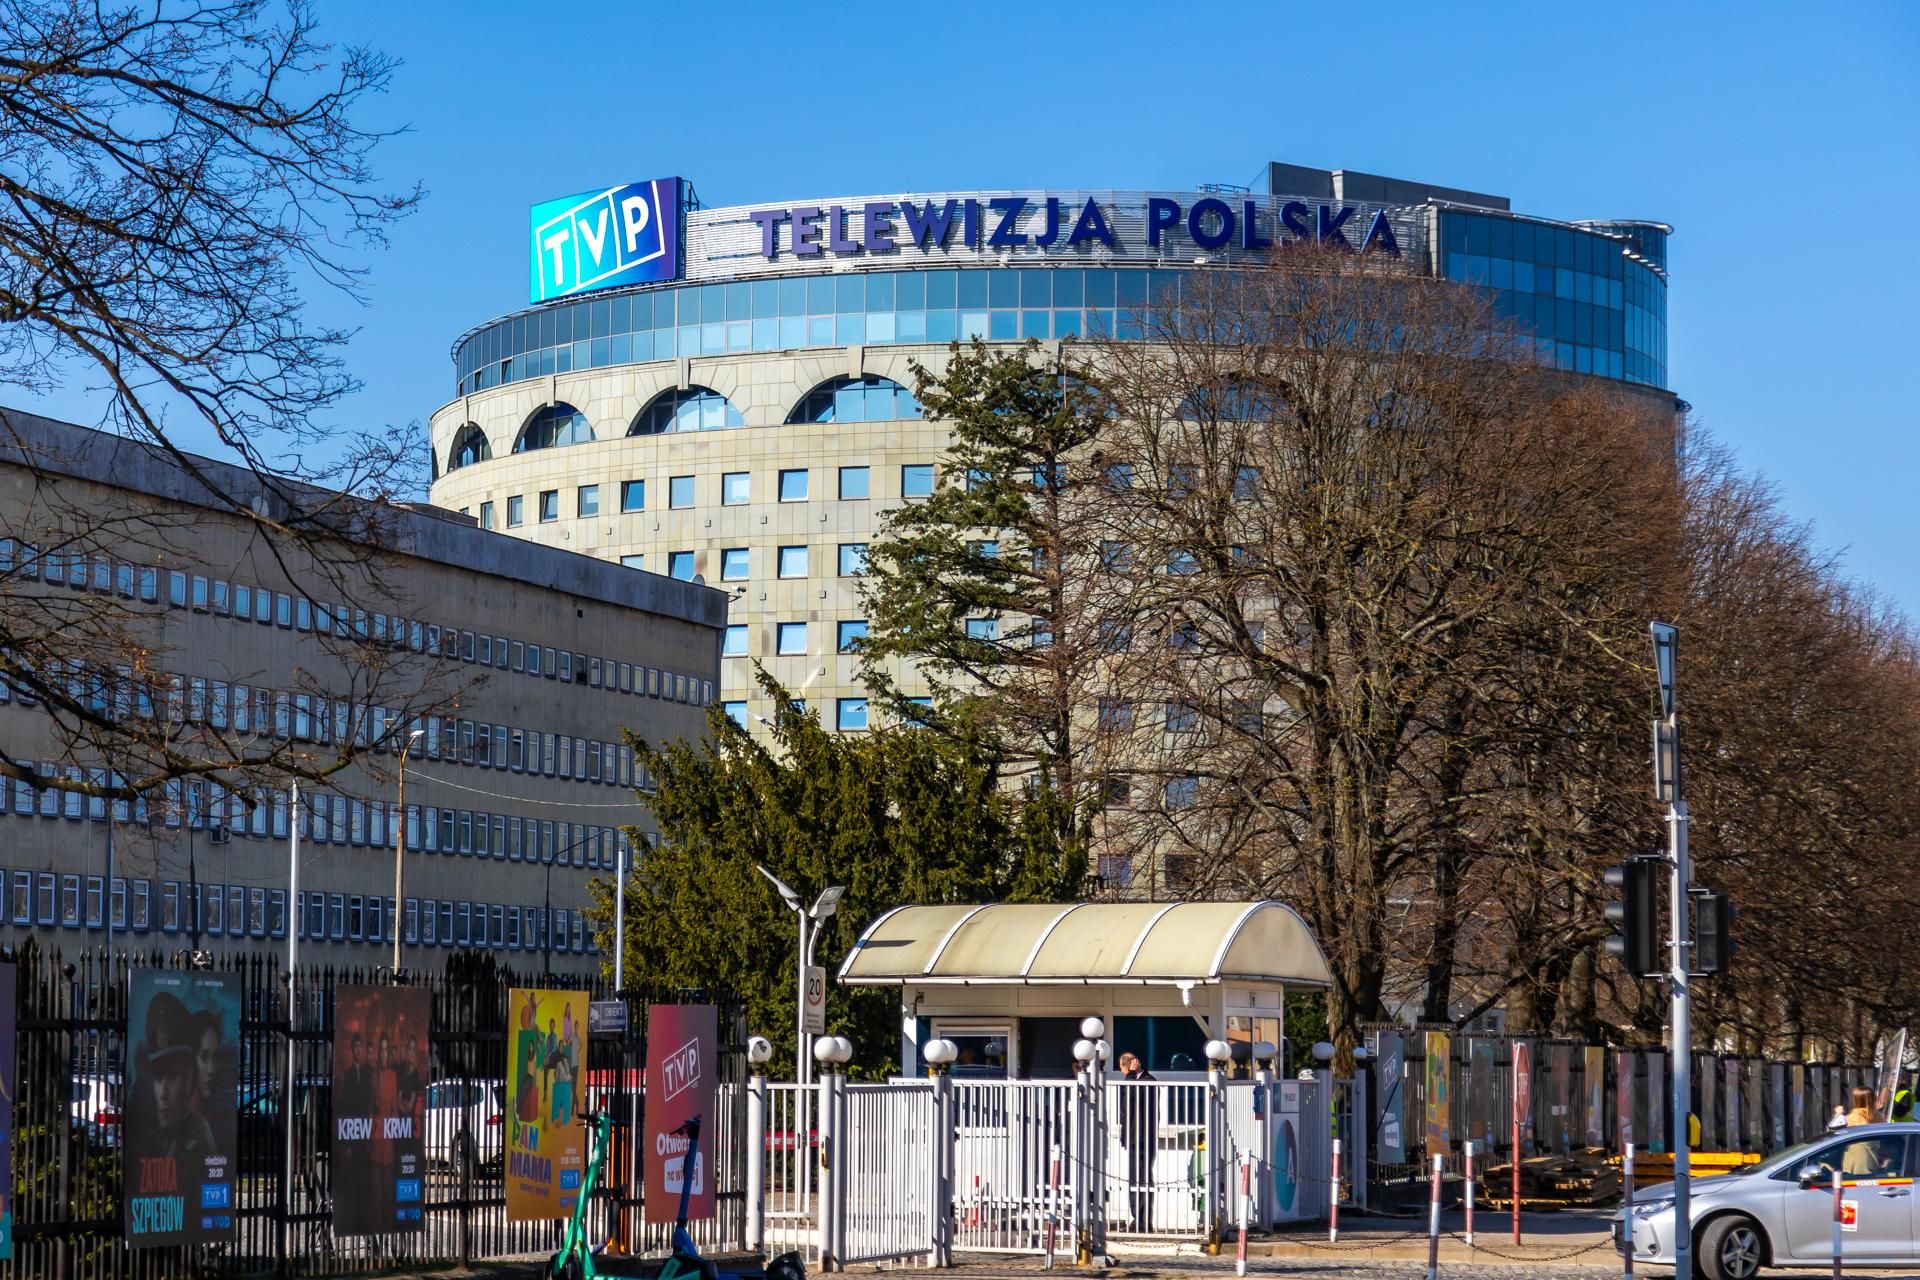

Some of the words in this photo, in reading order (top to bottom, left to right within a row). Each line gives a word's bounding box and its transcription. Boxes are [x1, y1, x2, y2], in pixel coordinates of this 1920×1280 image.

[543, 194, 650, 287] TVP
[749, 195, 1114, 257] TELEWIZJA
[1148, 197, 1400, 256] POLSKA
[809, 978, 821, 996] 20
[665, 1048, 697, 1091] TVP
[338, 1118, 373, 1140] KREW
[383, 1117, 412, 1139] KRWI
[512, 1119, 539, 1152] PAN
[656, 1132, 687, 1156] Otwórz
[139, 1157, 177, 1193] ZATOKA
[208, 1168, 224, 1178] 20:20
[509, 1150, 552, 1184] MAMA
[666, 1171, 675, 1182] na
[675, 1163, 699, 1186] wiej
[1286, 1146, 1295, 1185] A
[205, 1191, 220, 1202] TVP
[222, 1186, 227, 1204] 1
[132, 1195, 184, 1233] SZPIEGÓW
